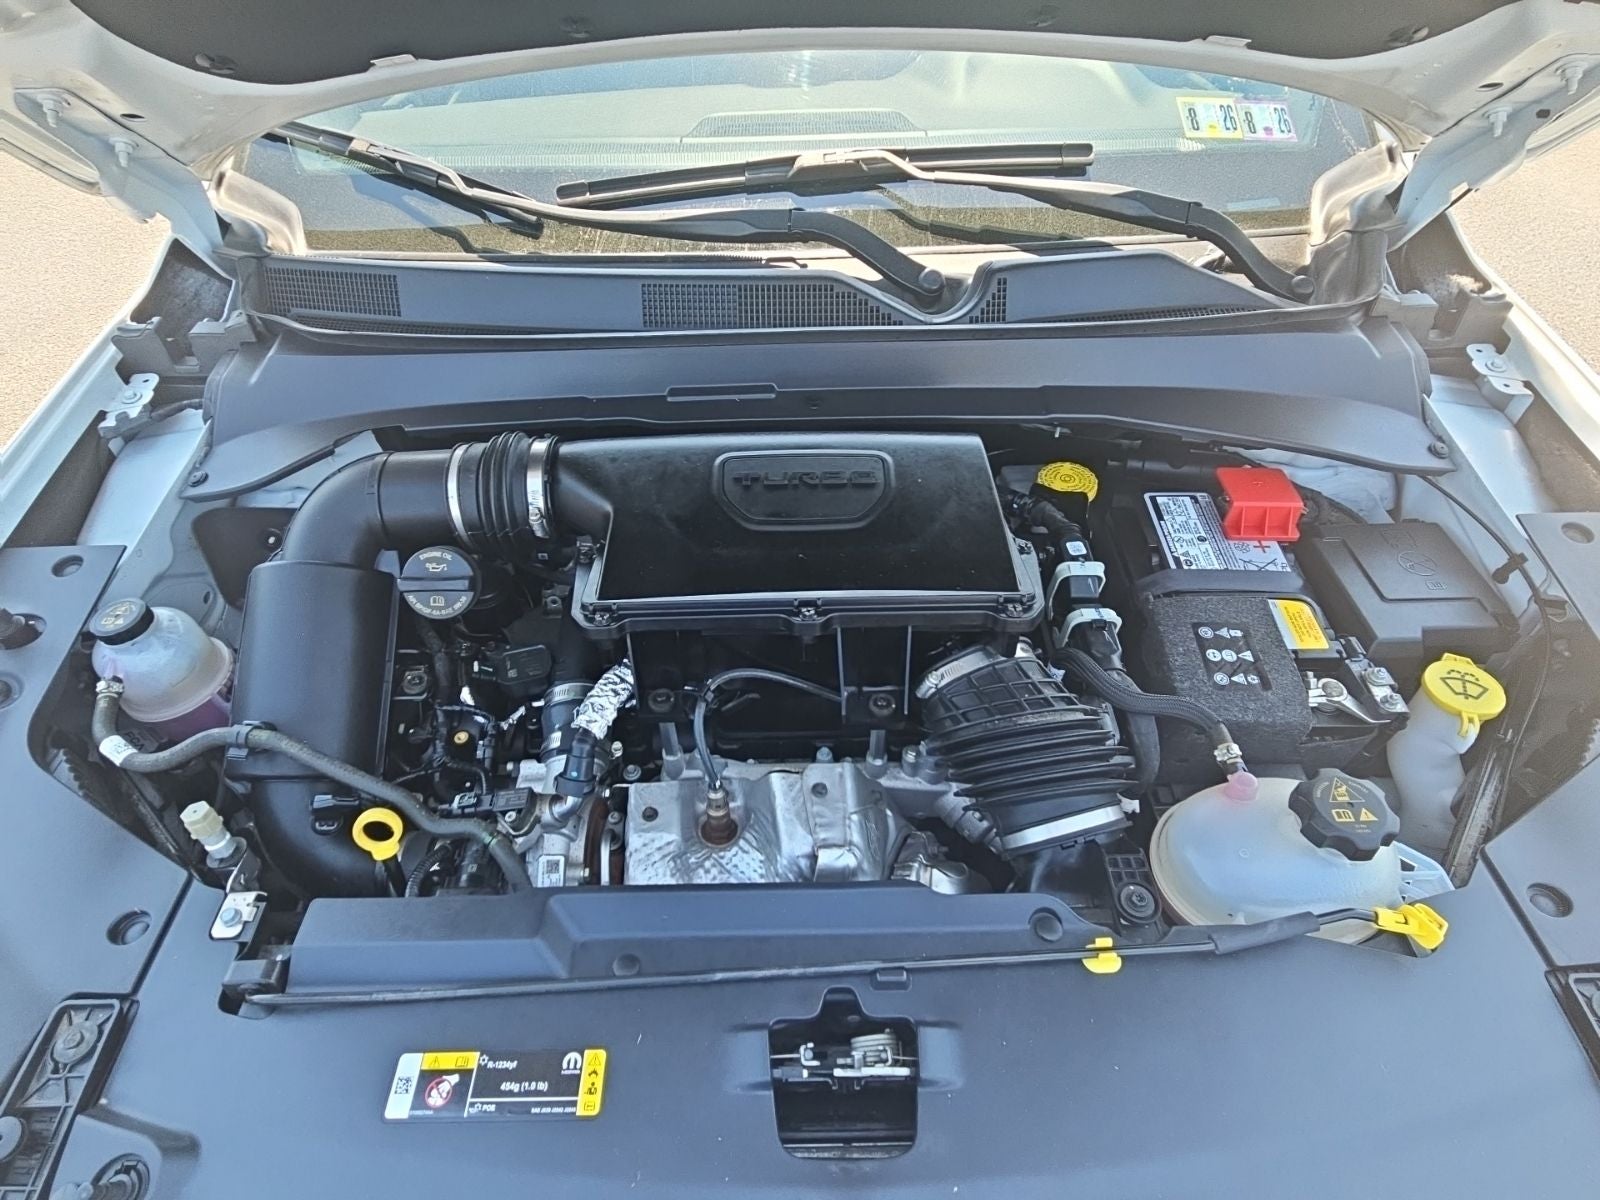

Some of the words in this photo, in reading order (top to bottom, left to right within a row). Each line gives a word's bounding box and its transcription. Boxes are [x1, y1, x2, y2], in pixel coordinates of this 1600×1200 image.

[1187, 107, 1200, 131] 8
[1220, 104, 1238, 131] 26
[1244, 110, 1257, 134] 8
[1274, 106, 1292, 133] 26
[732, 471, 880, 488] TURBO
[487, 1060, 518, 1071] R-1234yf
[500, 1081, 520, 1093] 454g
[536, 1081, 549, 1092] lb)
